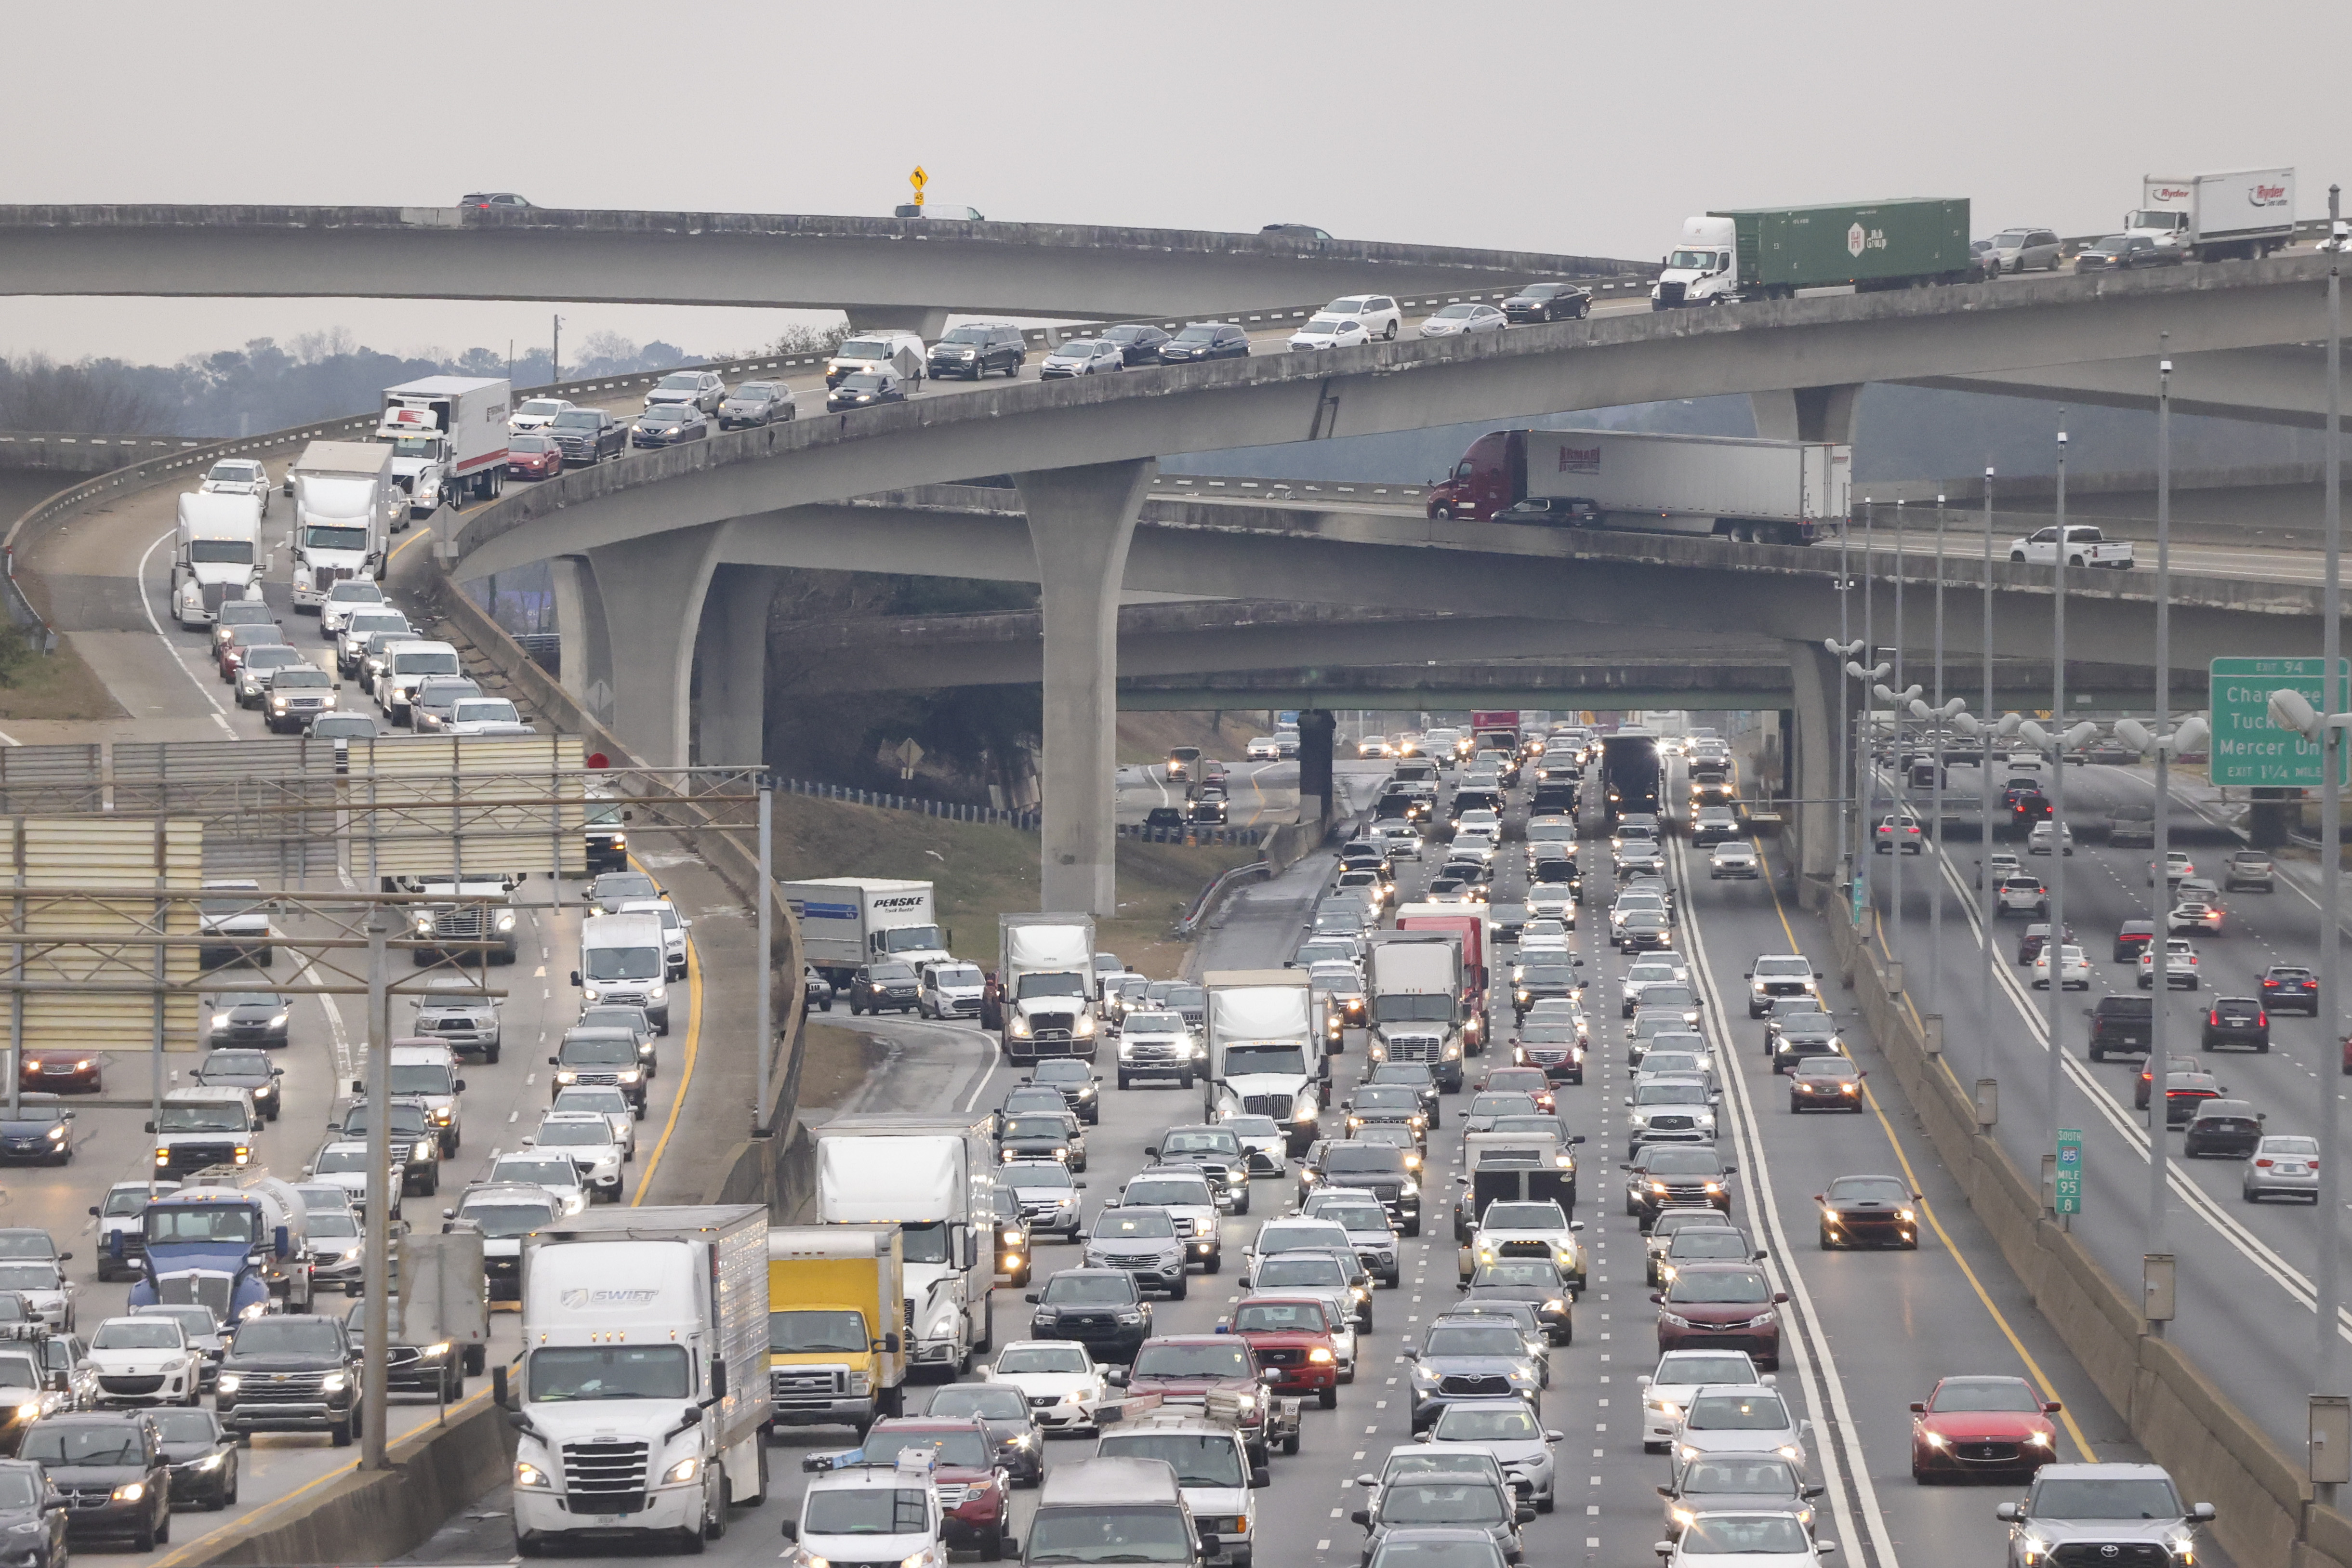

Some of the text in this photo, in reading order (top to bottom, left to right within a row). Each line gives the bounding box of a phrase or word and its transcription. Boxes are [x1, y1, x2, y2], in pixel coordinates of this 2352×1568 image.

[2161, 189, 2189, 198] Ryder
[1866, 237, 1886, 250] Group
[2256, 661, 2304, 673] EXIT 94
[2220, 739, 2321, 755] Mercer Un
[2227, 766, 2252, 777] EXIT
[873, 897, 924, 908] PENSKE
[2058, 1131, 2081, 1141] SOUTH
[2062, 1151, 2076, 1160] 85
[2058, 1170, 2080, 1180] MILE
[2061, 1181, 2077, 1193] 95
[593, 1290, 658, 1301] SWIFT
